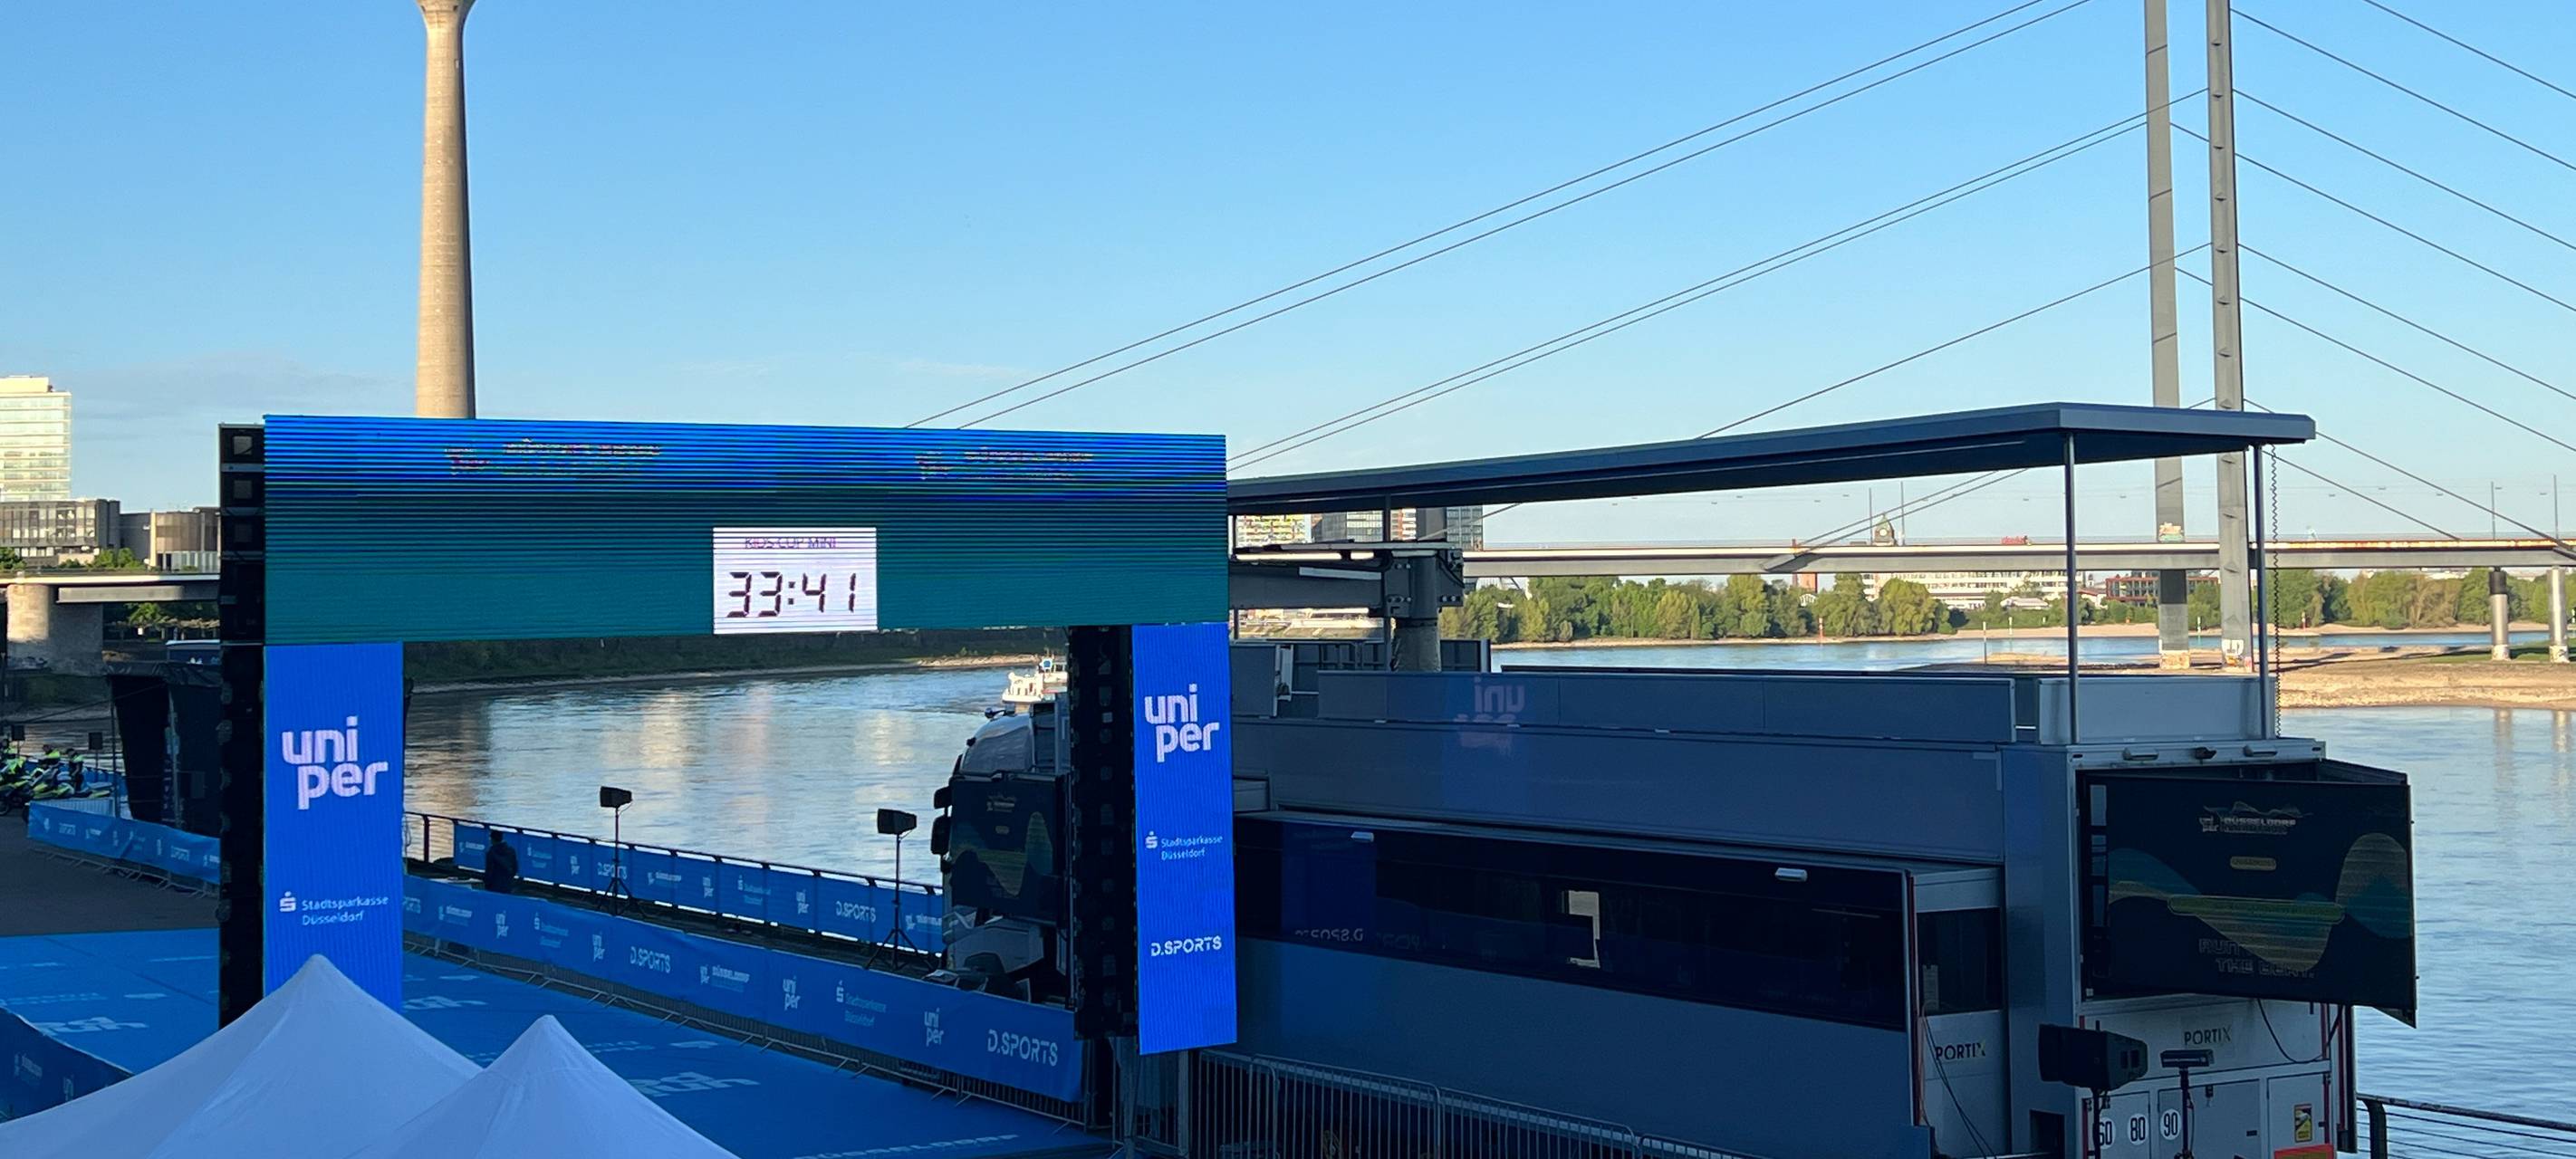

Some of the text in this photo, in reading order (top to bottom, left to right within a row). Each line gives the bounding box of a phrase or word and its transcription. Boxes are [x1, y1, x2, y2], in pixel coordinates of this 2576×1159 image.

[778, 536, 804, 549] CUP
[727, 571, 857, 618] 33:41
[1144, 683, 1198, 724] uni
[282, 715, 359, 764] uni
[1156, 721, 1220, 762] per
[297, 761, 389, 810] per
[1160, 834, 1224, 848] Stadtsparkasse
[302, 895, 389, 912] Stadtsparkasse
[1150, 934, 1223, 957] D.SPORTS
[630, 946, 671, 974] D.SPORTS
[924, 1007, 940, 1029] uni
[925, 1027, 945, 1048] per
[987, 1028, 1059, 1068] D.SPORTS
[2185, 1026, 2232, 1046] PORTIX
[1935, 1040, 1986, 1060] PORTIX
[2129, 1116, 2146, 1142] 80
[2163, 1112, 2178, 1137] 90
